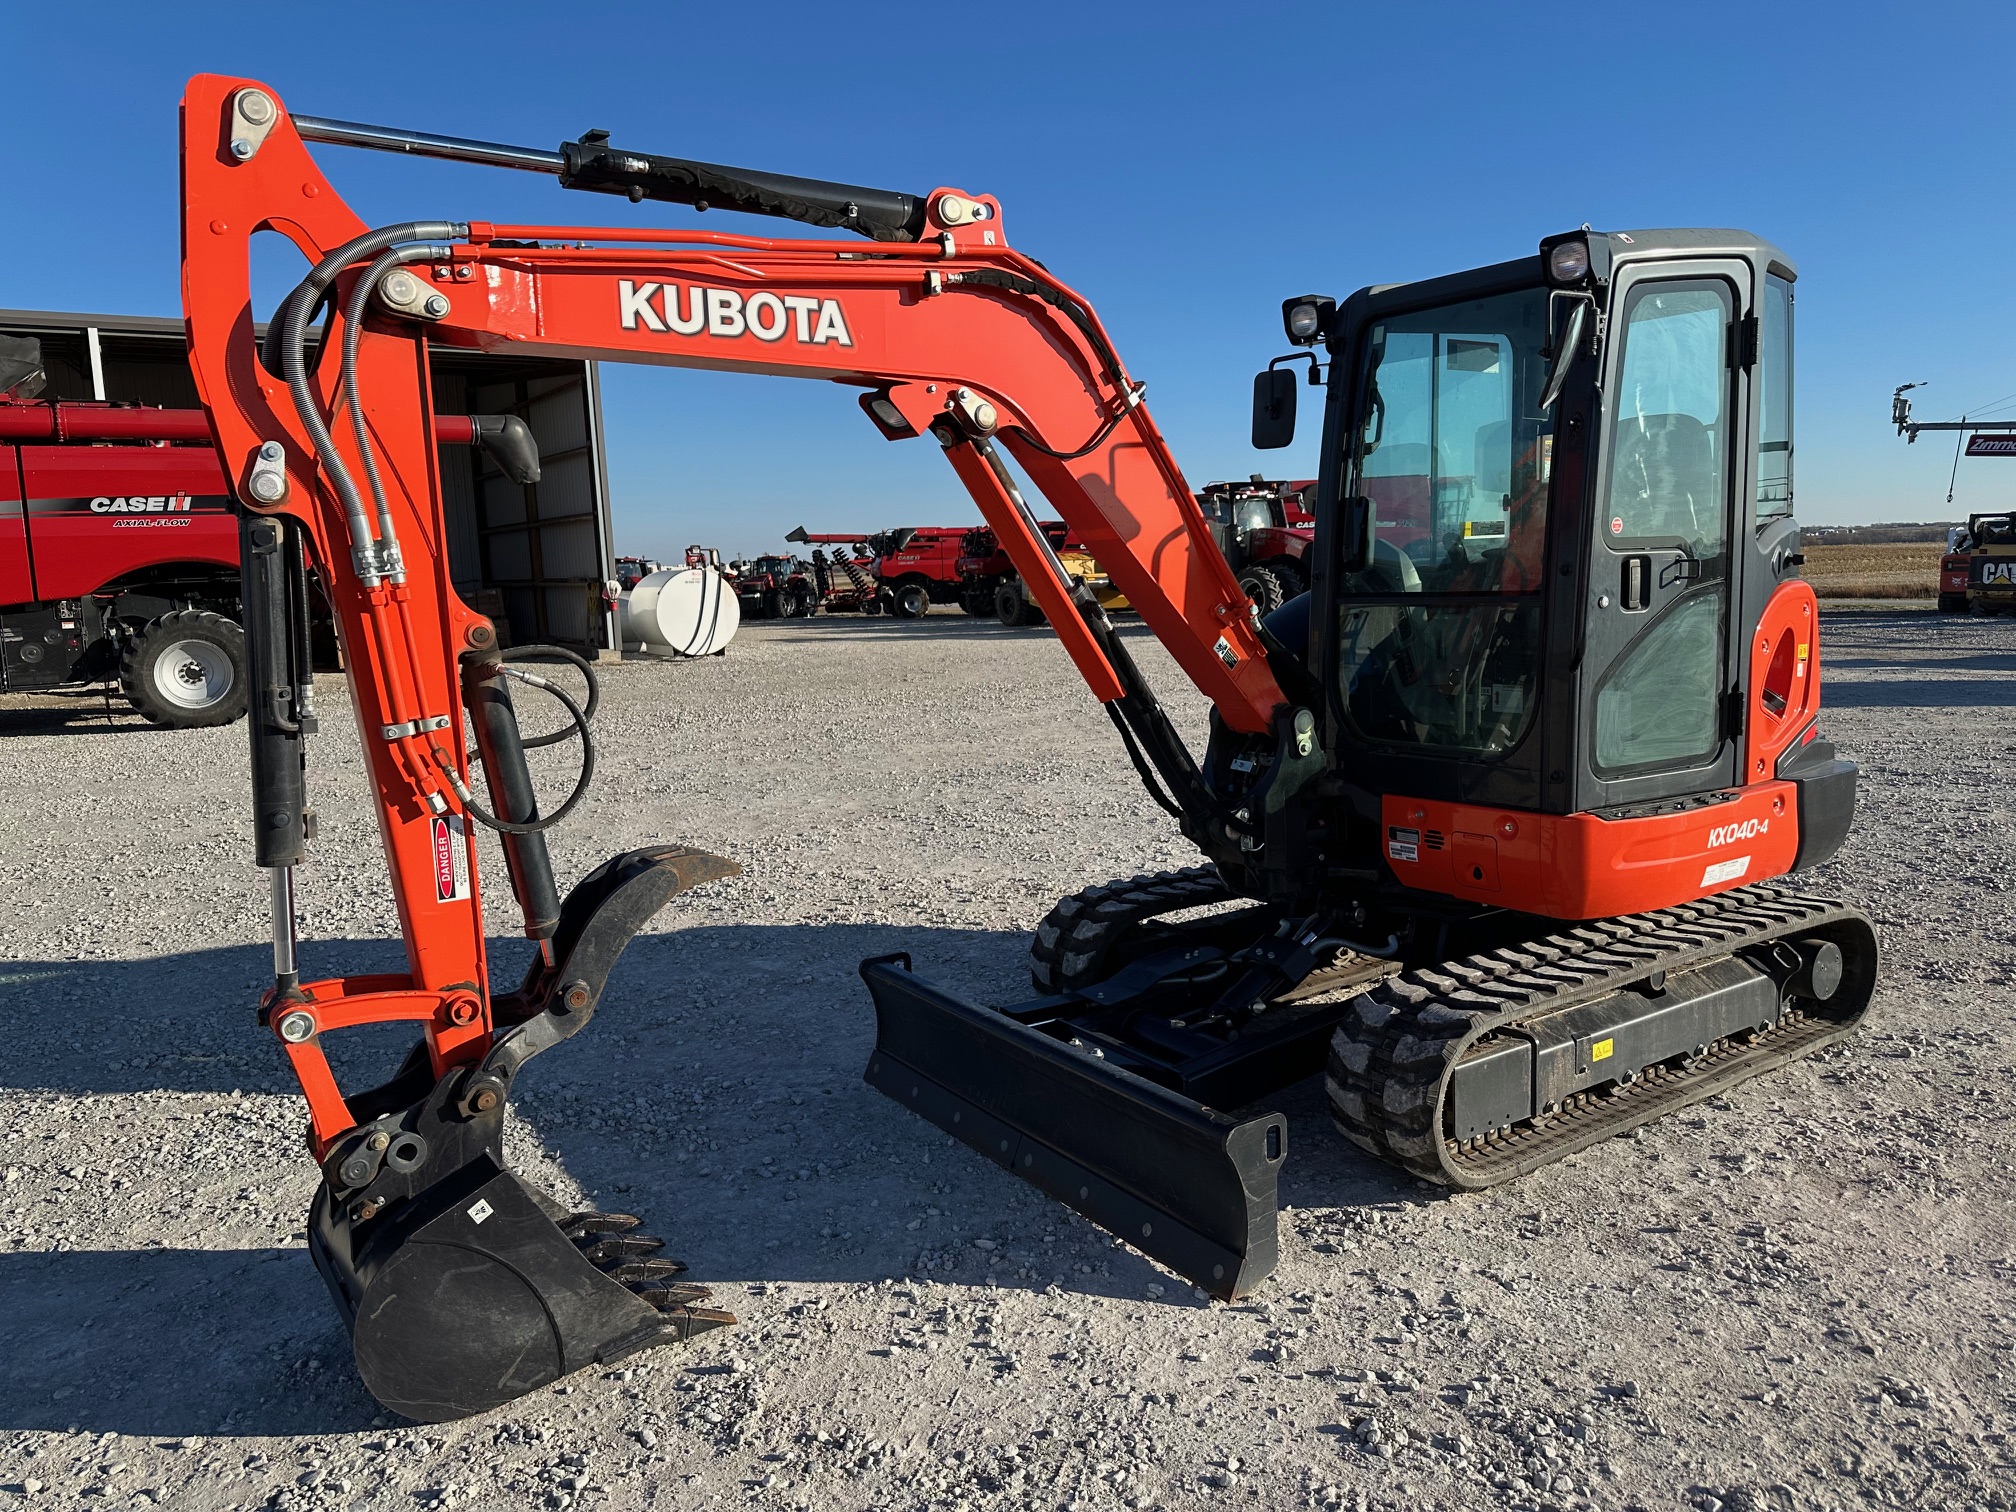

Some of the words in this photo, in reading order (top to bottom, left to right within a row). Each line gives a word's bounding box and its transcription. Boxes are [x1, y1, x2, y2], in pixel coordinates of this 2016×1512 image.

[617, 279, 853, 346] KUBOTA
[90, 497, 165, 513] CASE
[113, 518, 191, 528] AXIAL-FLOW
[1707, 818, 1769, 848] KX040-4
[438, 837, 450, 881] DANGER
